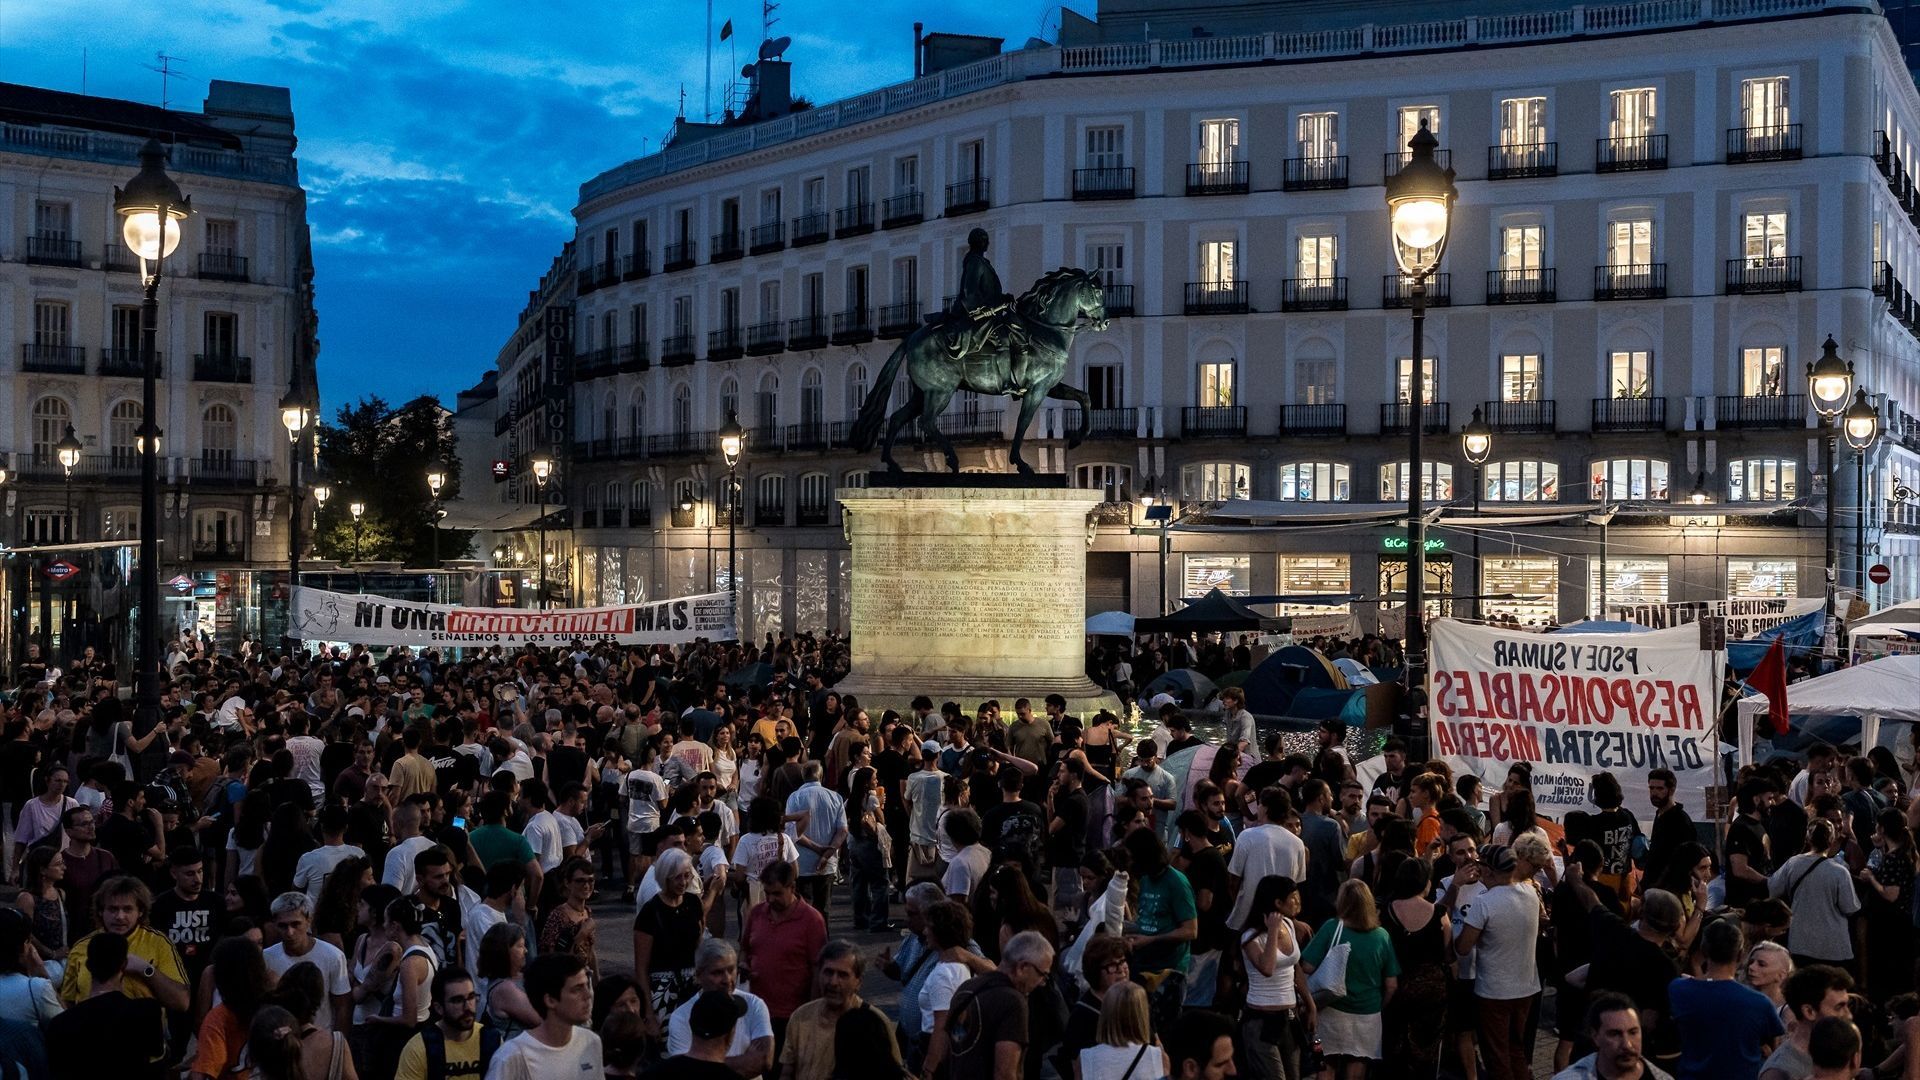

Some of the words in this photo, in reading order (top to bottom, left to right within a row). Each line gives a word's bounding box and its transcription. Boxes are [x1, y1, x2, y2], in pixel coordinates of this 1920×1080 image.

[550, 309, 565, 386] HOTEL
[550, 399, 565, 505] MODERNO
[1384, 538, 1394, 547] El
[1424, 539, 1445, 551] glés
[355, 601, 386, 628] NI
[391, 606, 446, 631] UNA
[1717, 601, 1728, 616] EL
[1731, 599, 1786, 616] RENTISMO
[1727, 618, 1749, 635] SUS
[508, 634, 515, 642] A
[524, 633, 545, 642] LOS
[554, 633, 617, 642] CULPABLES
[173, 910, 210, 928] JUST
[168, 927, 194, 943] DO
